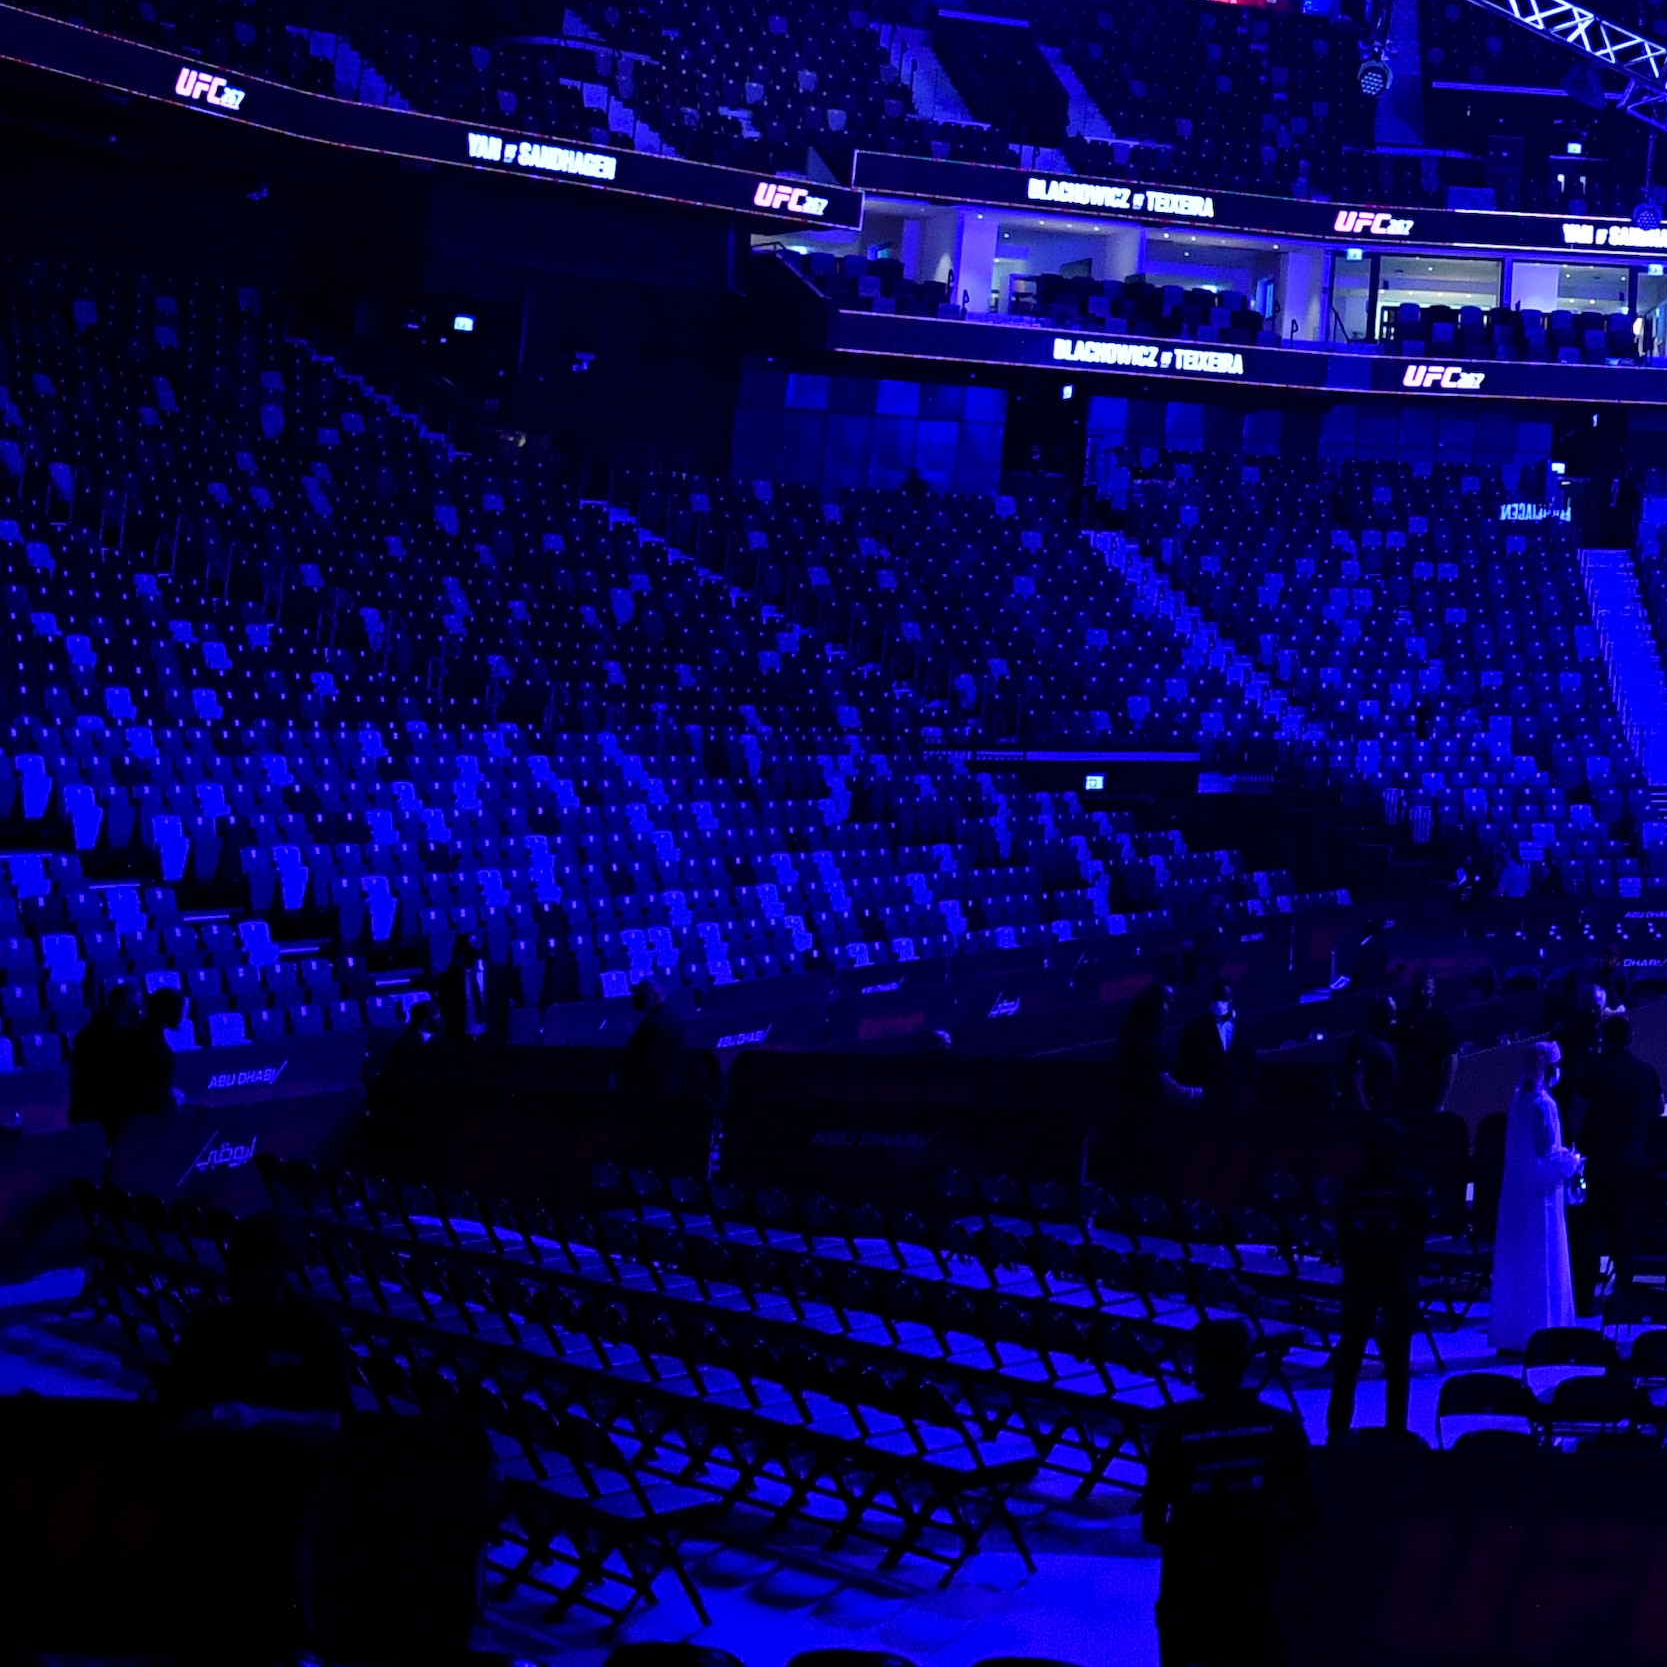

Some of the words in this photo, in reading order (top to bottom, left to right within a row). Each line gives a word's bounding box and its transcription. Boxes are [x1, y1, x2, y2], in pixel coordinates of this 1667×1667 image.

[175, 67, 228, 105] UFC
[468, 133, 502, 162] YAN
[518, 142, 617, 180] SANDHAGEN
[753, 181, 808, 211] UFC
[1146, 191, 1215, 218] TEIXEIRA
[1333, 210, 1391, 235] UFC
[1174, 348, 1244, 375] TEIXEIRA
[1402, 365, 1463, 389] UFC
[207, 1073, 236, 1089] ABU
